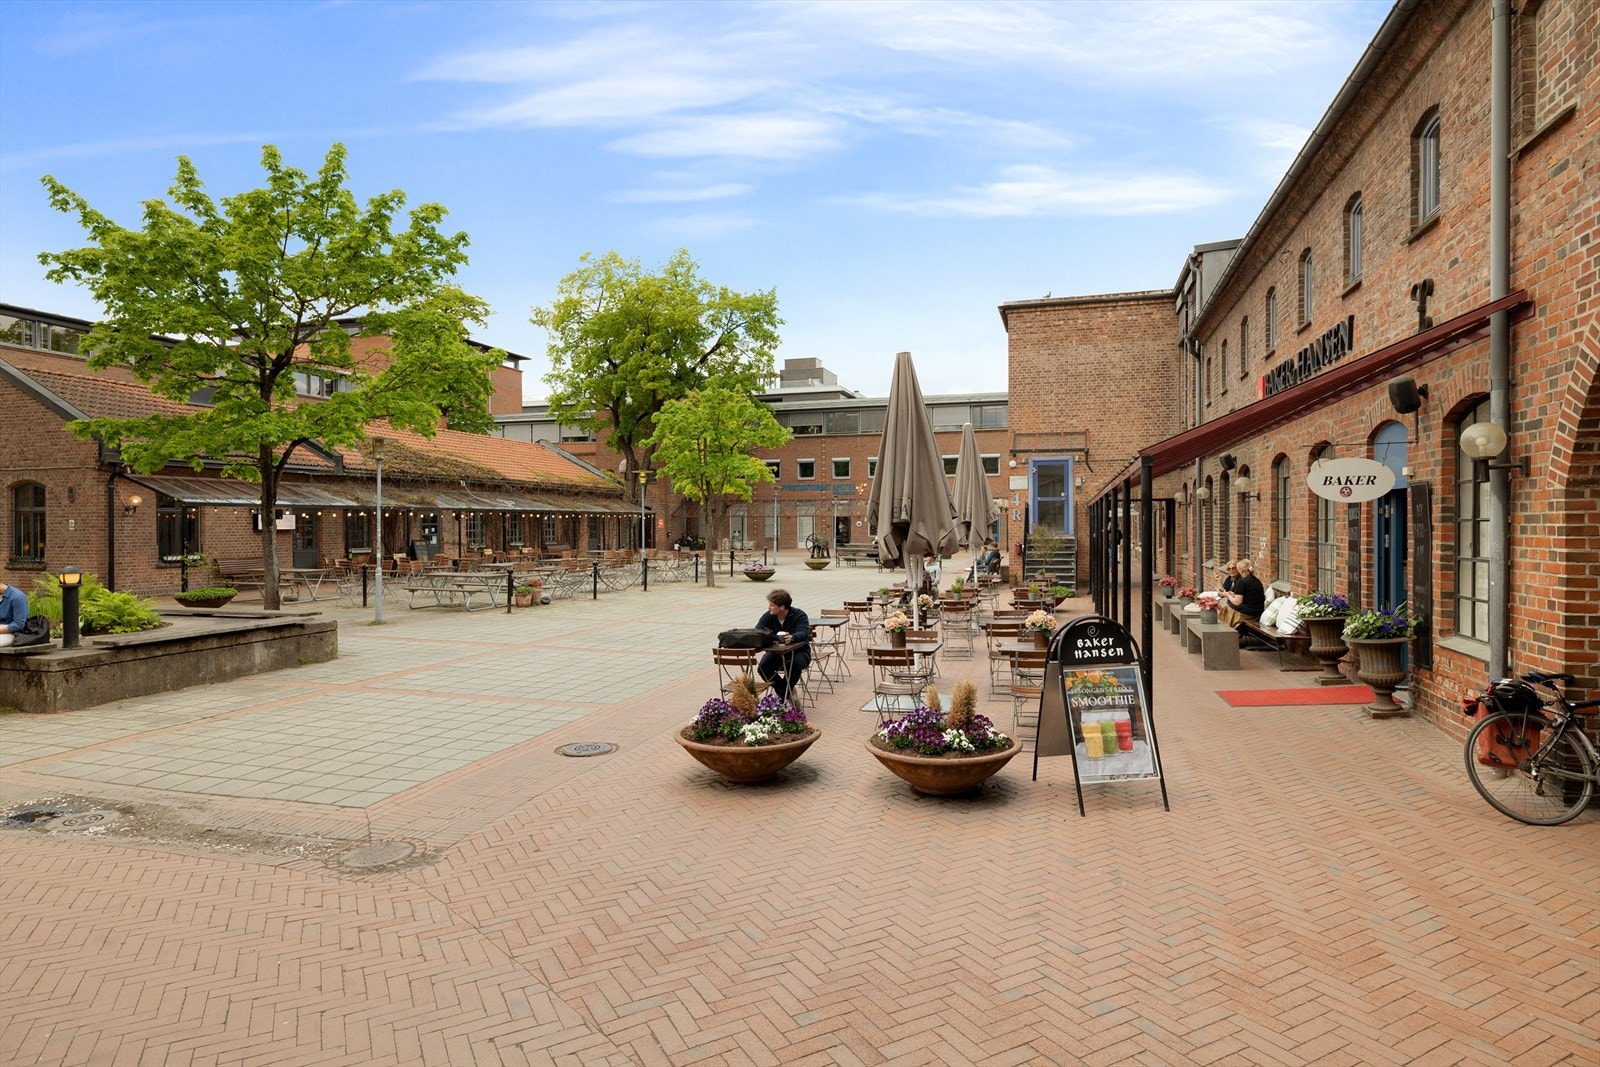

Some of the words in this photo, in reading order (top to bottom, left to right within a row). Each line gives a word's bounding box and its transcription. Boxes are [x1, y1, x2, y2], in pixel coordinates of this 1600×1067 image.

[1297, 314, 1354, 382] HANSEN
[1322, 475, 1377, 486] BAKER
[1011, 493, 1020, 507] 4
[1012, 509, 1021, 520] R
[1071, 694, 1136, 707] SMOOTHIE
